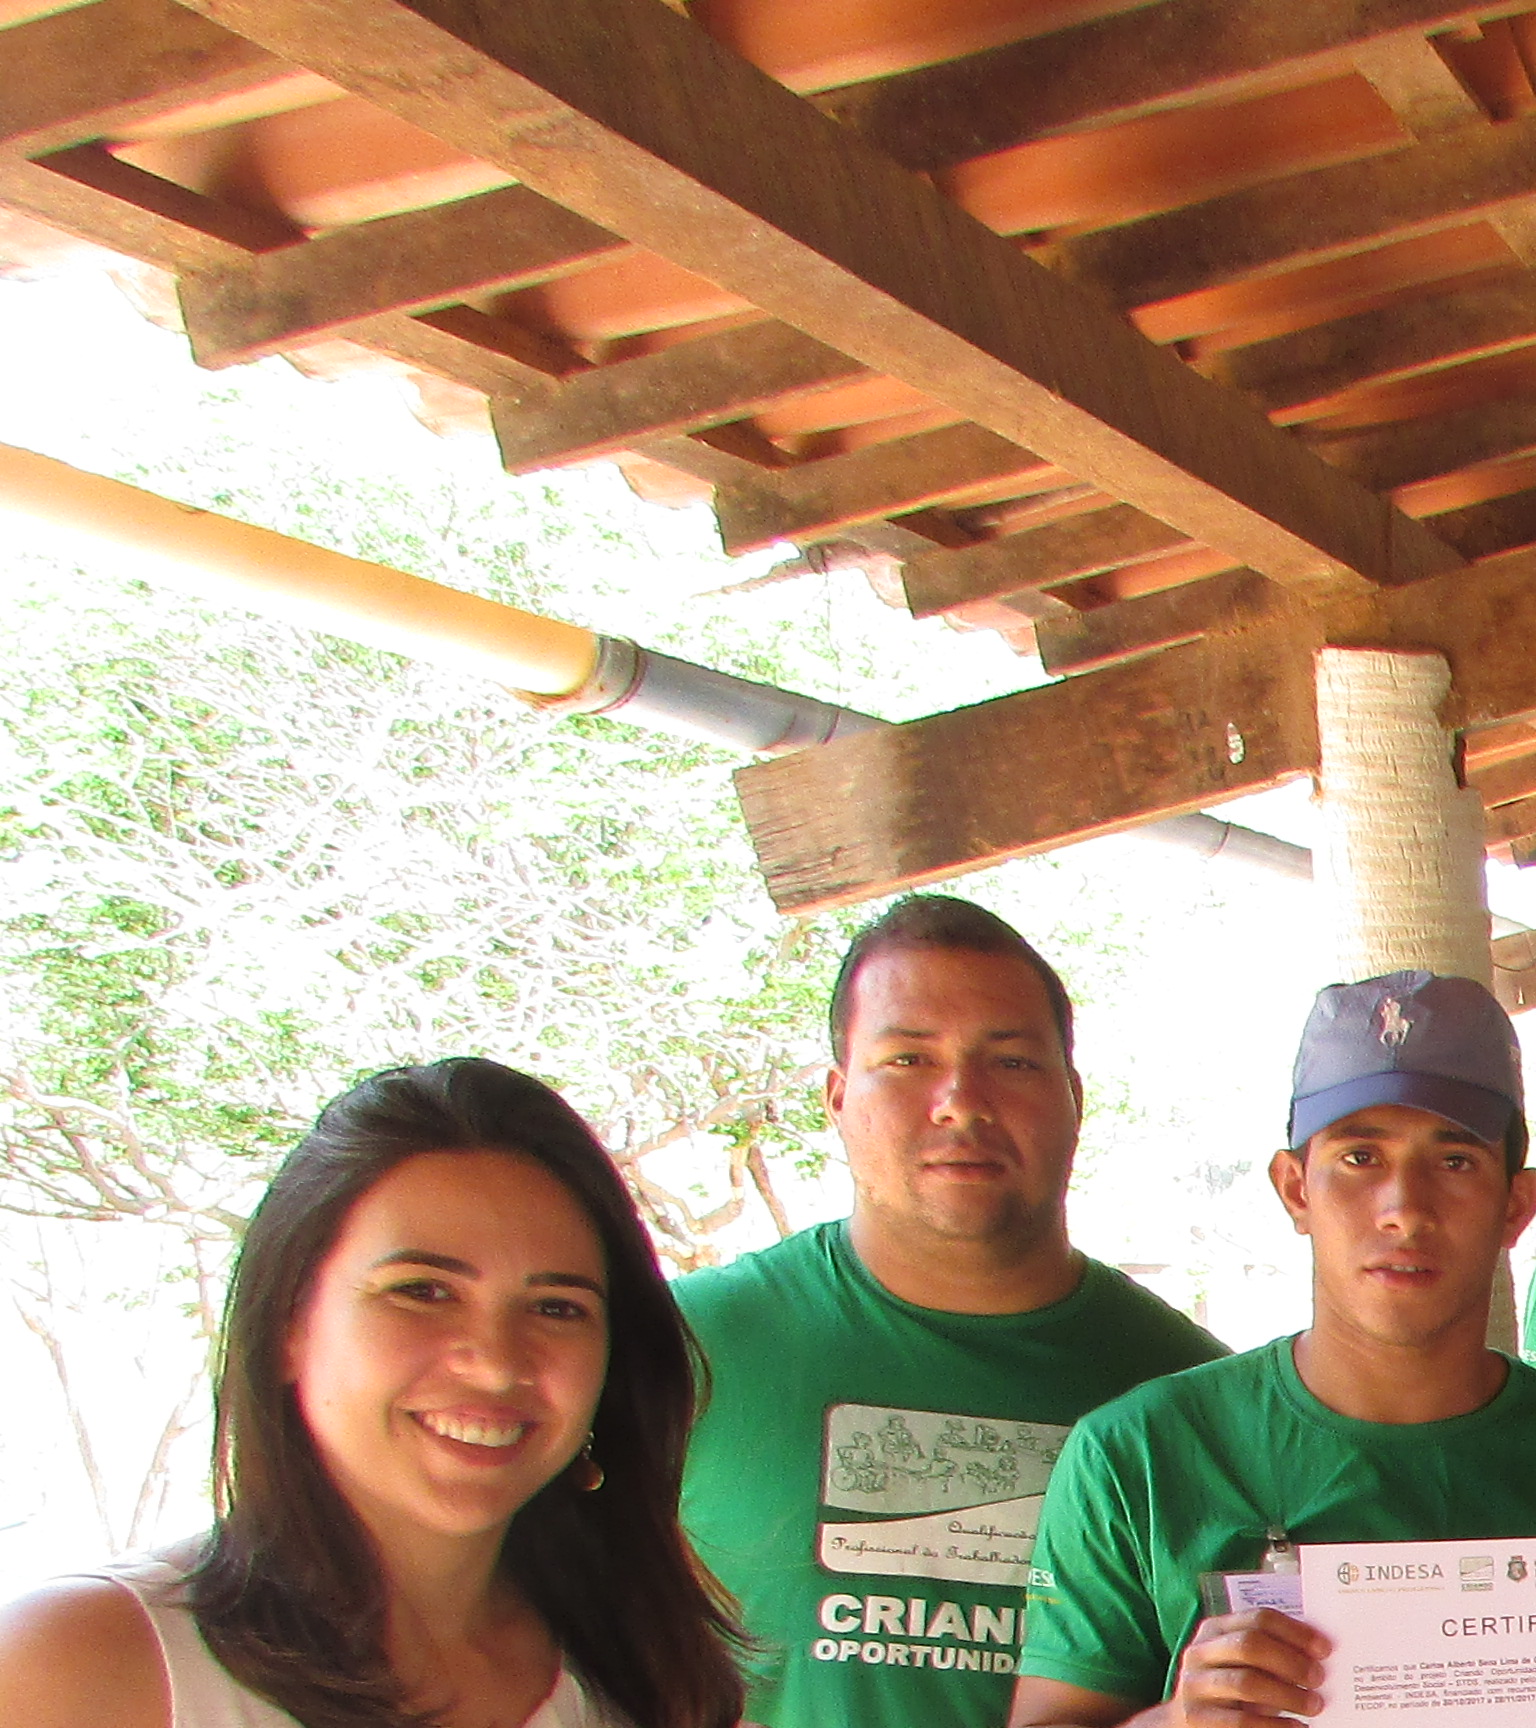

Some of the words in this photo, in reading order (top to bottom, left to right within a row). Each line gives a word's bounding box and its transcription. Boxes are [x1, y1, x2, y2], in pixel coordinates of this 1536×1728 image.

[1365, 1564, 1444, 1581] INDESA
[819, 1593, 1027, 1645] CRIAN
[812, 1638, 1019, 1675] OPORTUNID
